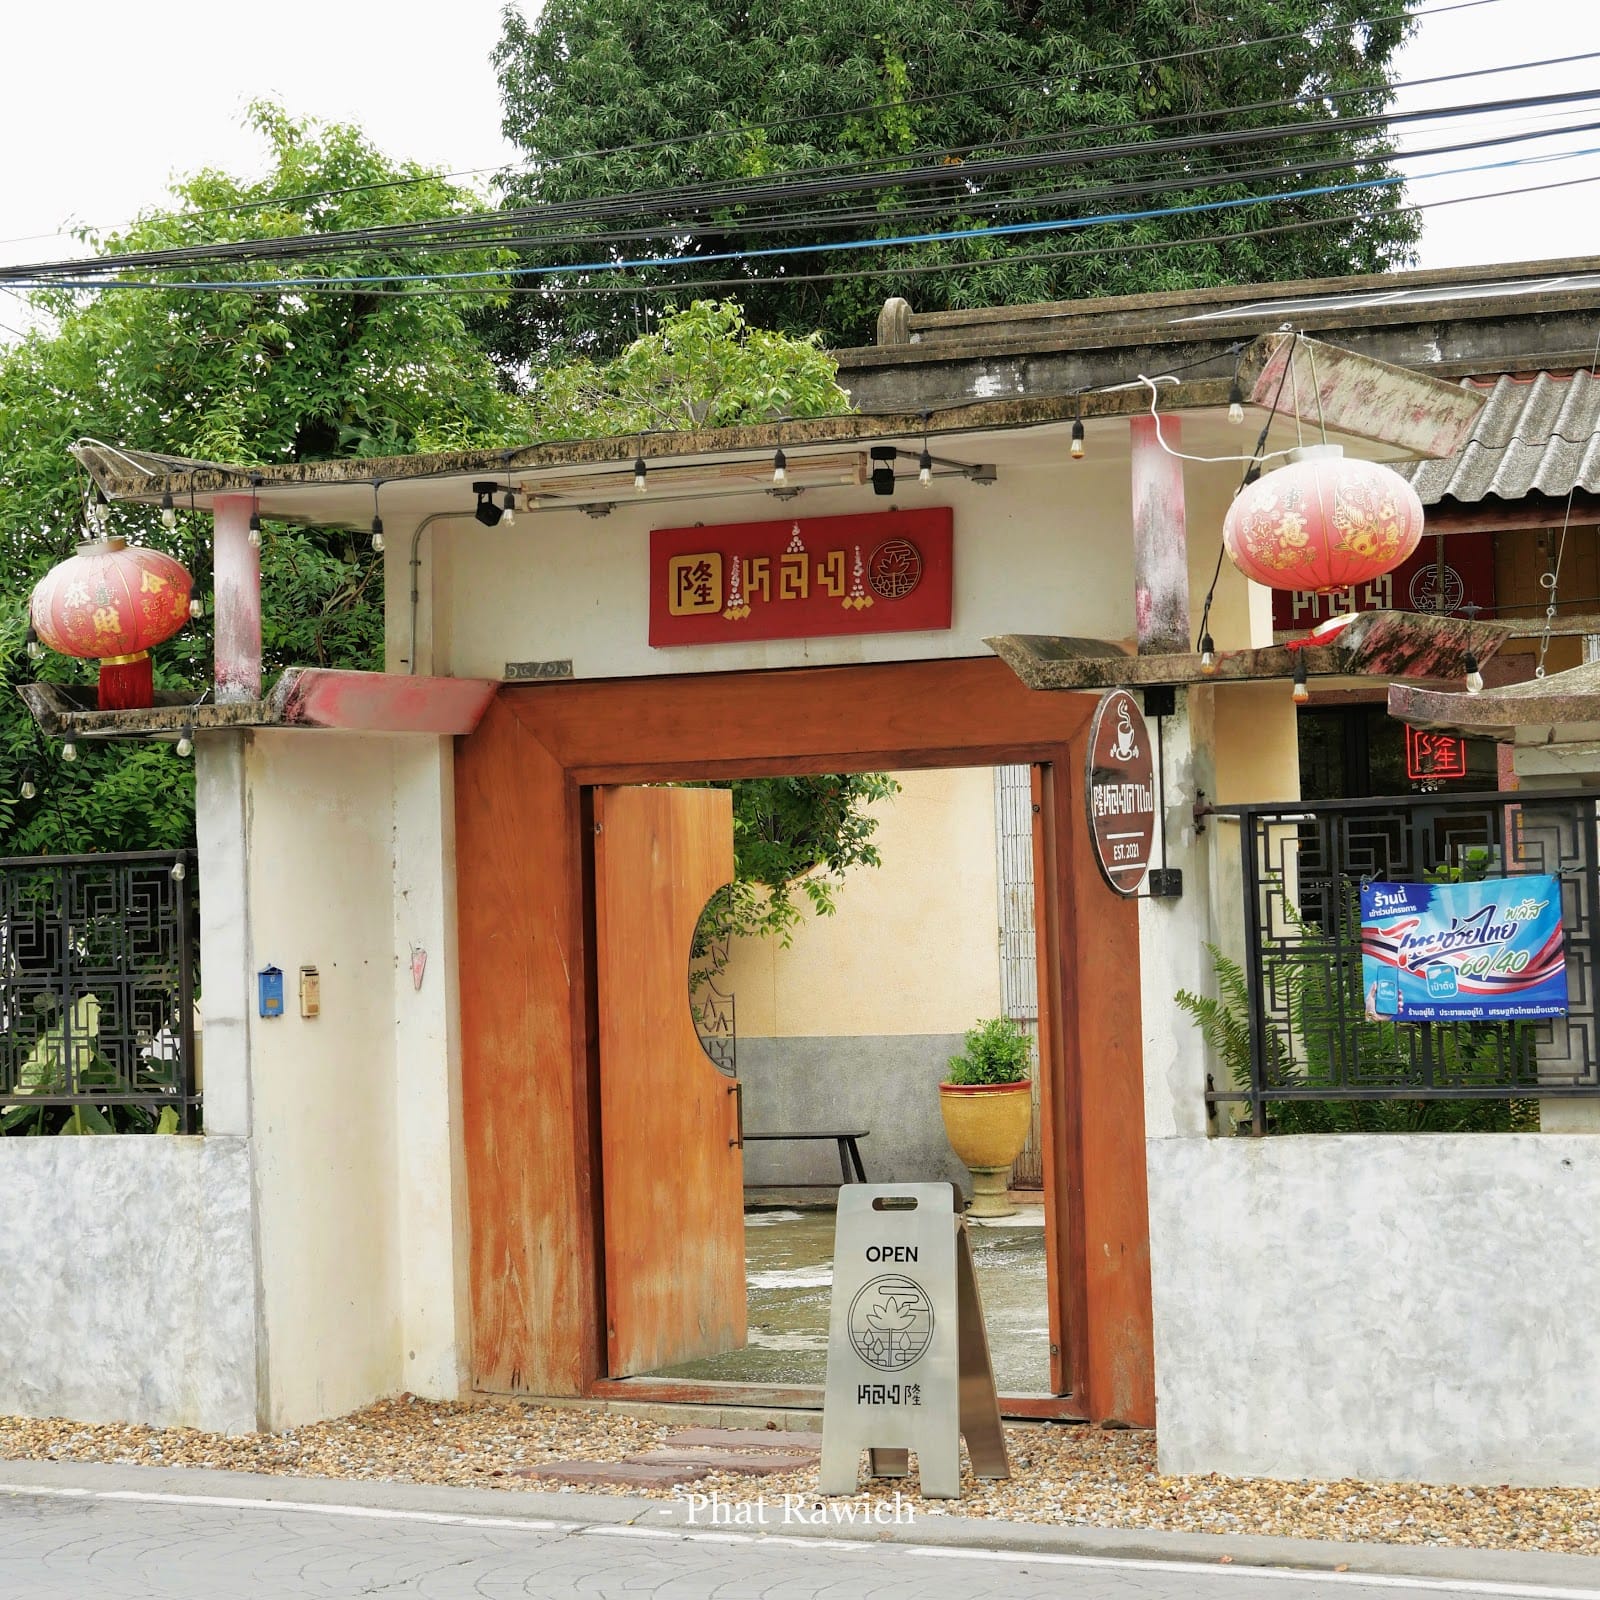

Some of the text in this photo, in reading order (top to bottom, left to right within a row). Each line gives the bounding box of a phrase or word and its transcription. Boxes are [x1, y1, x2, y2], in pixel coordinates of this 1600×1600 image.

[1113, 843, 1140, 860] EST. 2021
[1374, 885, 1408, 907] ร้านนี้
[1504, 899, 1550, 920] พลัส
[1458, 947, 1530, 981] 60/40
[865, 1246, 919, 1263] OPEN
